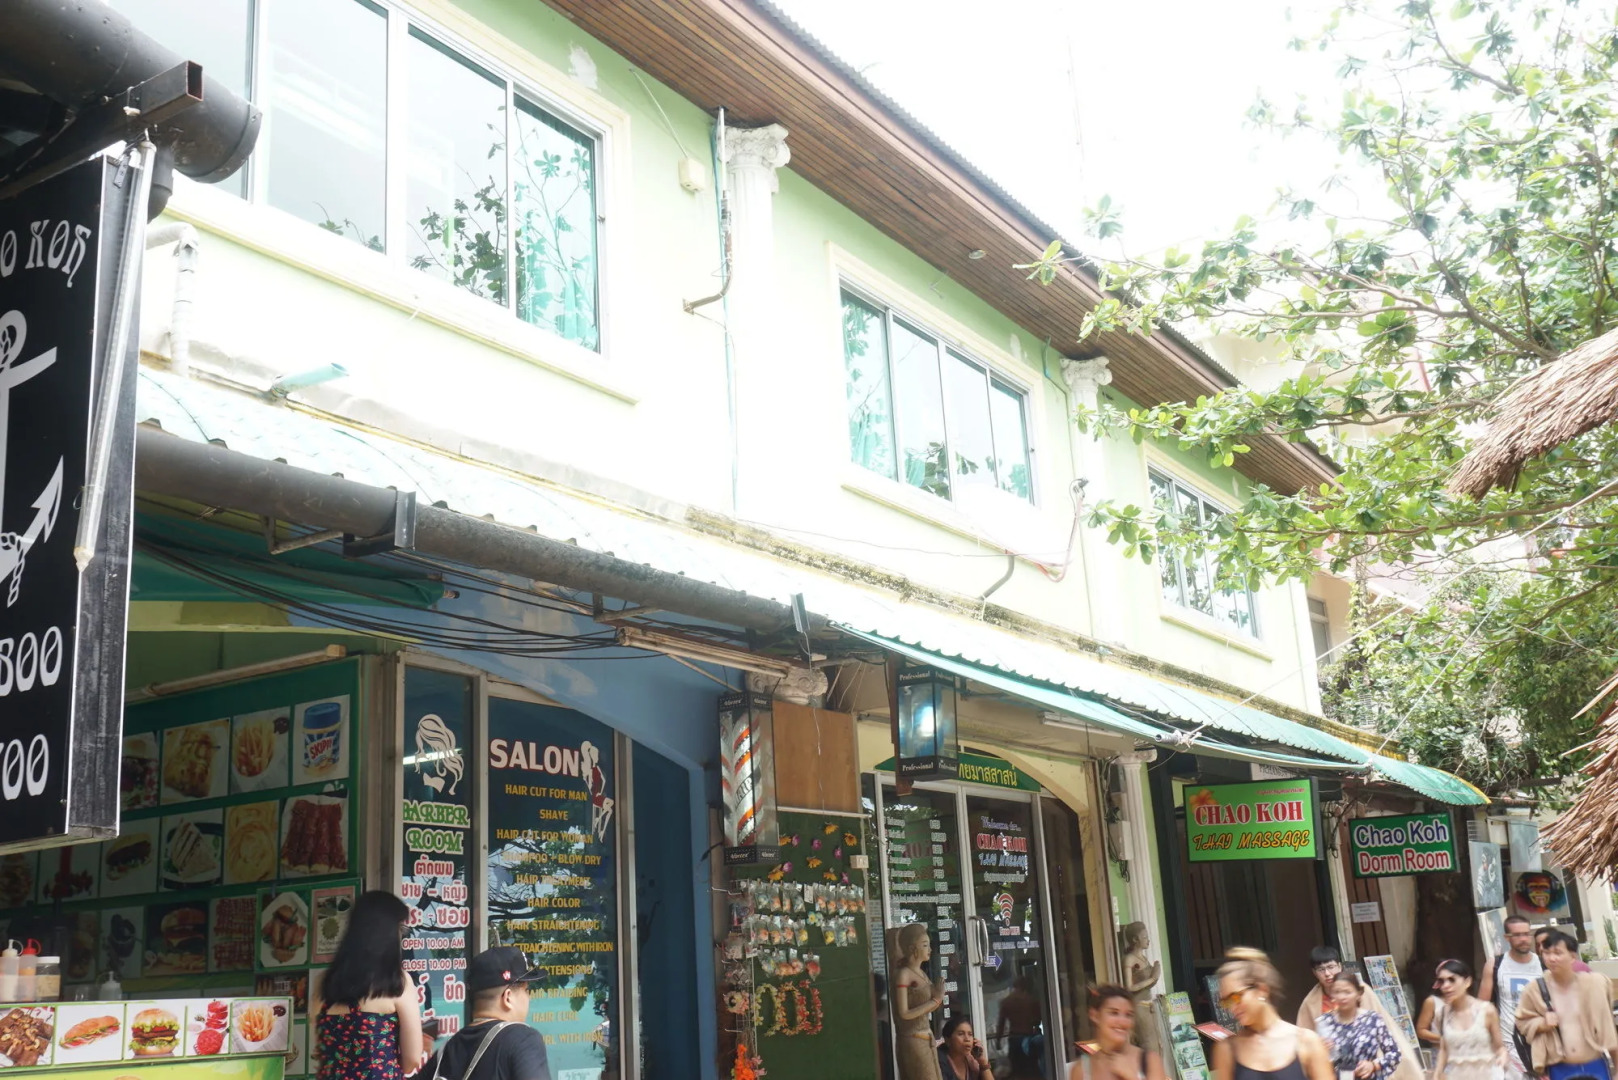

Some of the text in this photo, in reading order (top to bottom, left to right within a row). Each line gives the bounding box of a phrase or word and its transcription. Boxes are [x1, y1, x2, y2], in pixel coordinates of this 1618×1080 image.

[900, 670, 931, 681] Professional
[490, 738, 580, 778] SALON
[0, 734, 49, 800] OO
[902, 762, 934, 772] Professional
[505, 784, 588, 801] HAIR CUT FOR MAN
[402, 801, 469, 826] BARBER
[1194, 801, 1305, 826] CHAO KOH
[406, 829, 463, 853] ROOM
[497, 829, 594, 844] HAIR CUT FOR WOMAN
[1193, 829, 1310, 852] THAI MASSAGE
[1355, 819, 1449, 847] Chao Koh
[977, 833, 1028, 853] CHAO KOH
[558, 853, 582, 864] BLOW
[585, 855, 602, 866] DRY
[1358, 848, 1452, 875] Dorm Room
[516, 874, 538, 885] HAIR
[527, 898, 581, 908] HAIR COLOR
[507, 920, 530, 931] HAIR
[402, 938, 465, 950] OPEN 10.00 AM
[402, 959, 467, 971] CLOSE 10.00 PM
